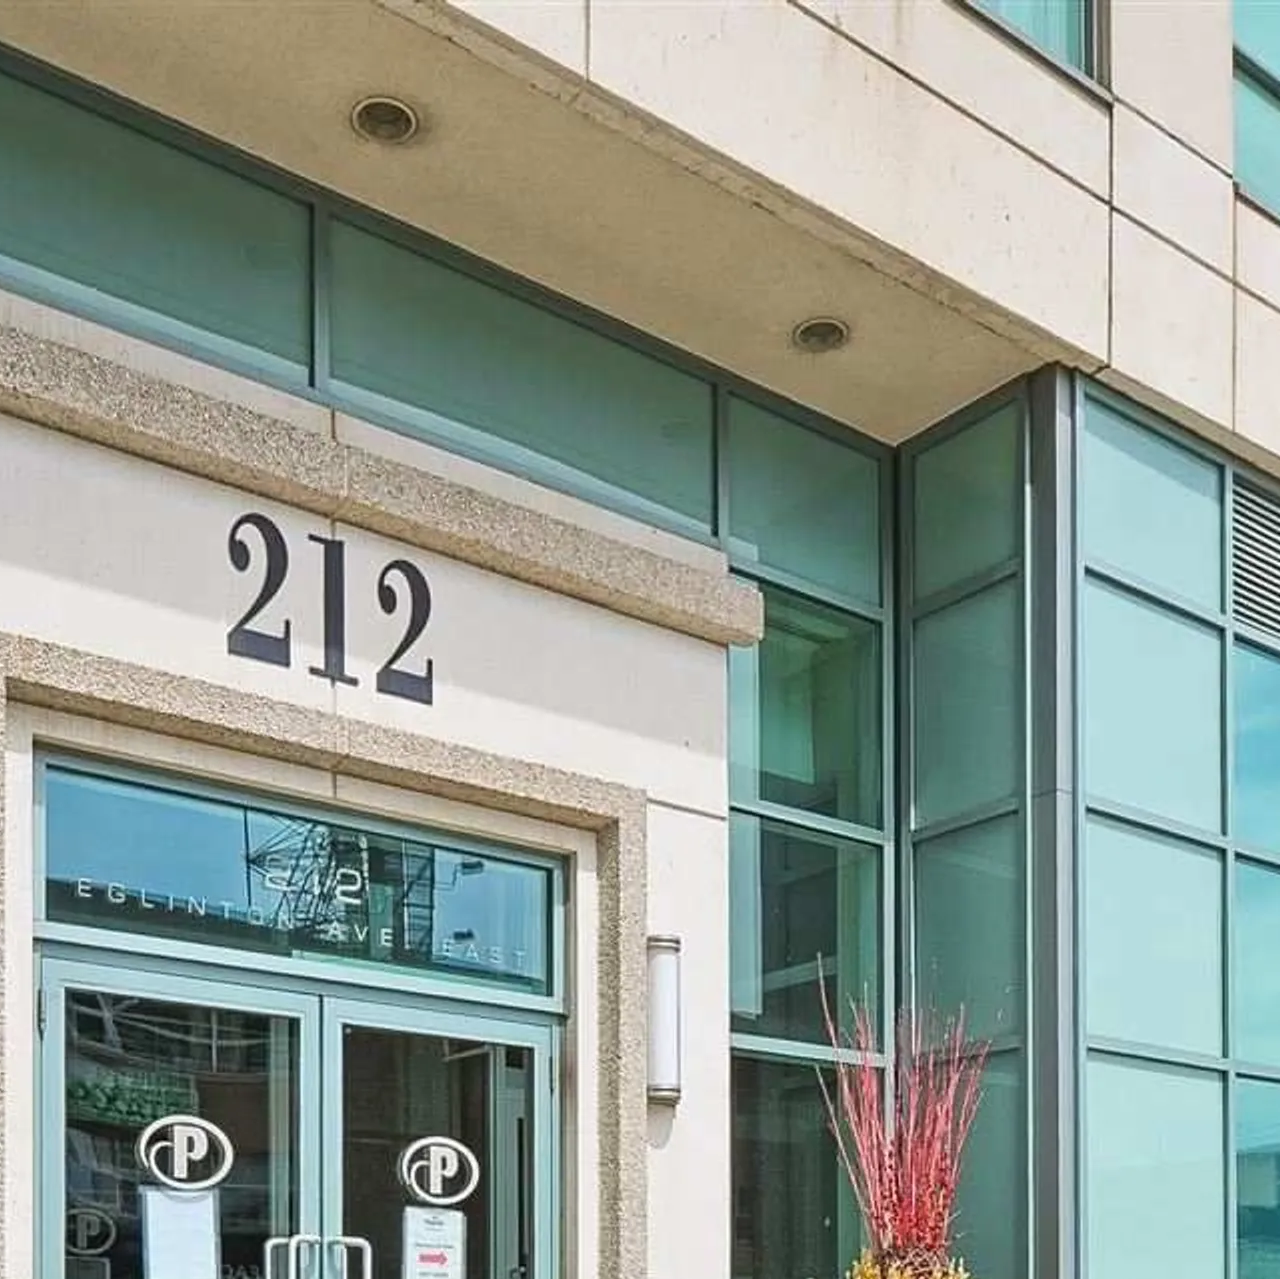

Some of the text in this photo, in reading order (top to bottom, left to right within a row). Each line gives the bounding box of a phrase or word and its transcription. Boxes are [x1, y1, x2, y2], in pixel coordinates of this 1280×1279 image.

[227, 512, 433, 706] 212
[77, 877, 526, 967] EGLINTON AVE EAST
